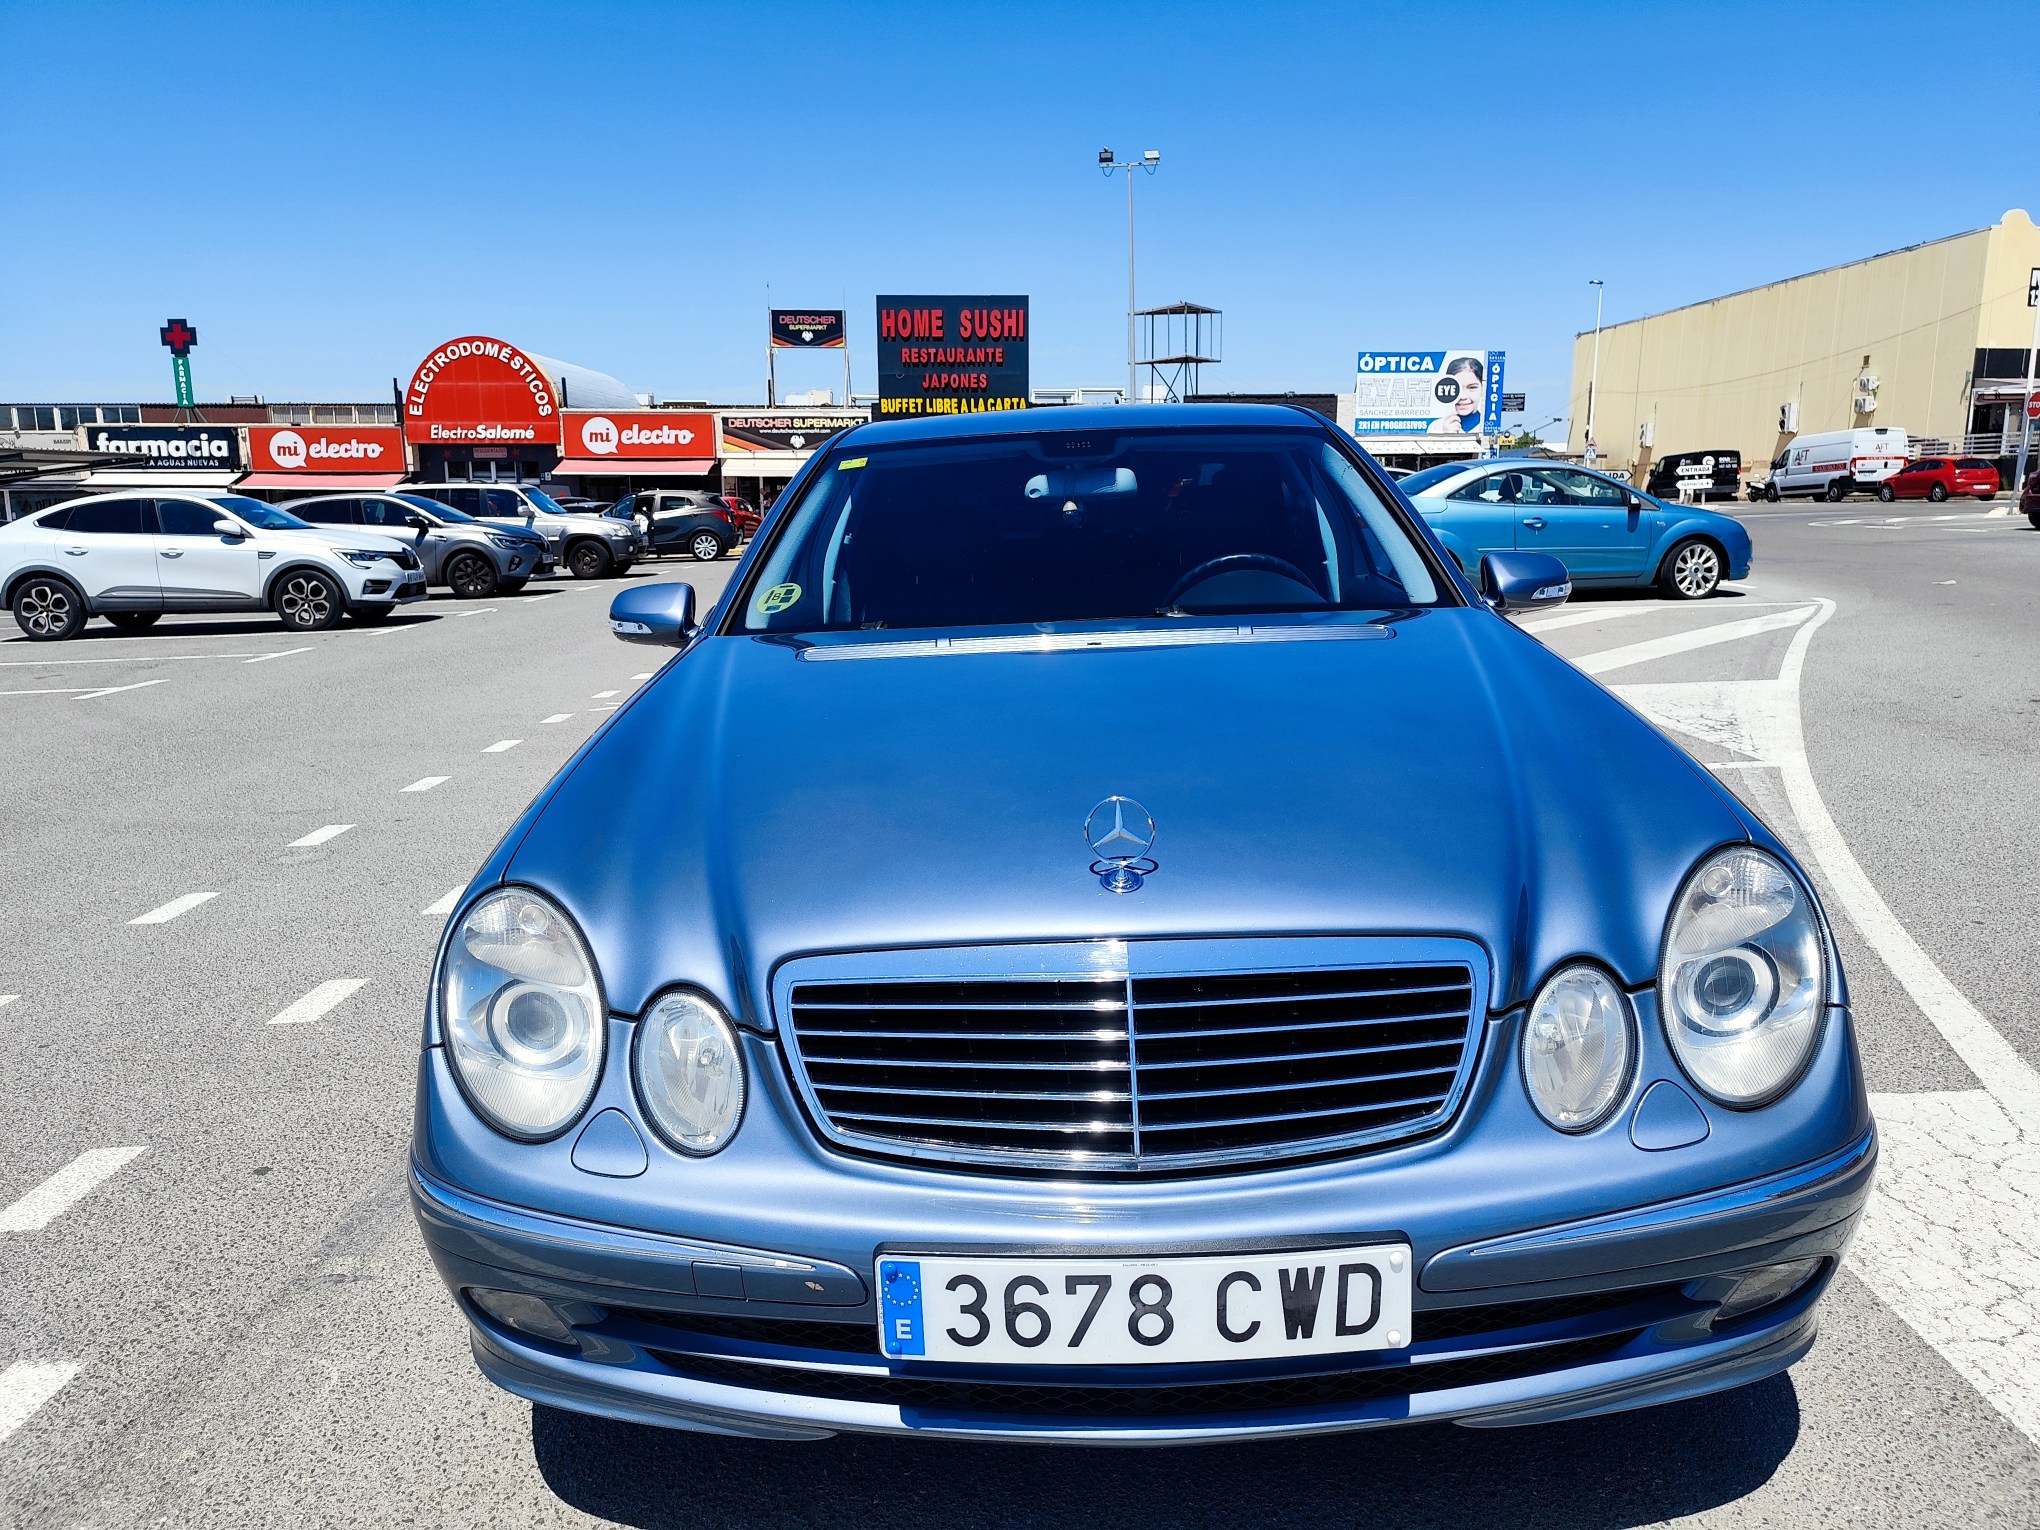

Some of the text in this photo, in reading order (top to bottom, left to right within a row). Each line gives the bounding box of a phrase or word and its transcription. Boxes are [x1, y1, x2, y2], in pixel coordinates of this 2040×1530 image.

[779, 315, 836, 324] DEUTSCHER
[881, 309, 1025, 339] HOME SUSHI
[901, 348, 1004, 363] RESTAURANTE
[1359, 353, 1435, 372] ÓPTICA
[177, 358, 189, 405] FARMACIA
[408, 340, 553, 418] ELECTRODOMÉSTICOS
[922, 373, 988, 389] JAPONES
[1437, 384, 1457, 396] EYE
[881, 398, 1027, 415] BUFFET LIBRE A LA CARTA
[2028, 401, 2040, 409] STO
[728, 417, 865, 428] DEUTSCHER SUPERMARKT
[430, 424, 536, 440] ElectroSalomé
[589, 424, 695, 445] mi electro
[96, 432, 230, 457] farmacia
[276, 437, 384, 459] mi electro
[157, 459, 185, 467] AGUAS
[187, 459, 219, 467] NUEVAS
[1681, 466, 1711, 474] ENTRADA
[945, 1262, 1383, 1348] 3678 CWD
[895, 1319, 912, 1339] E
